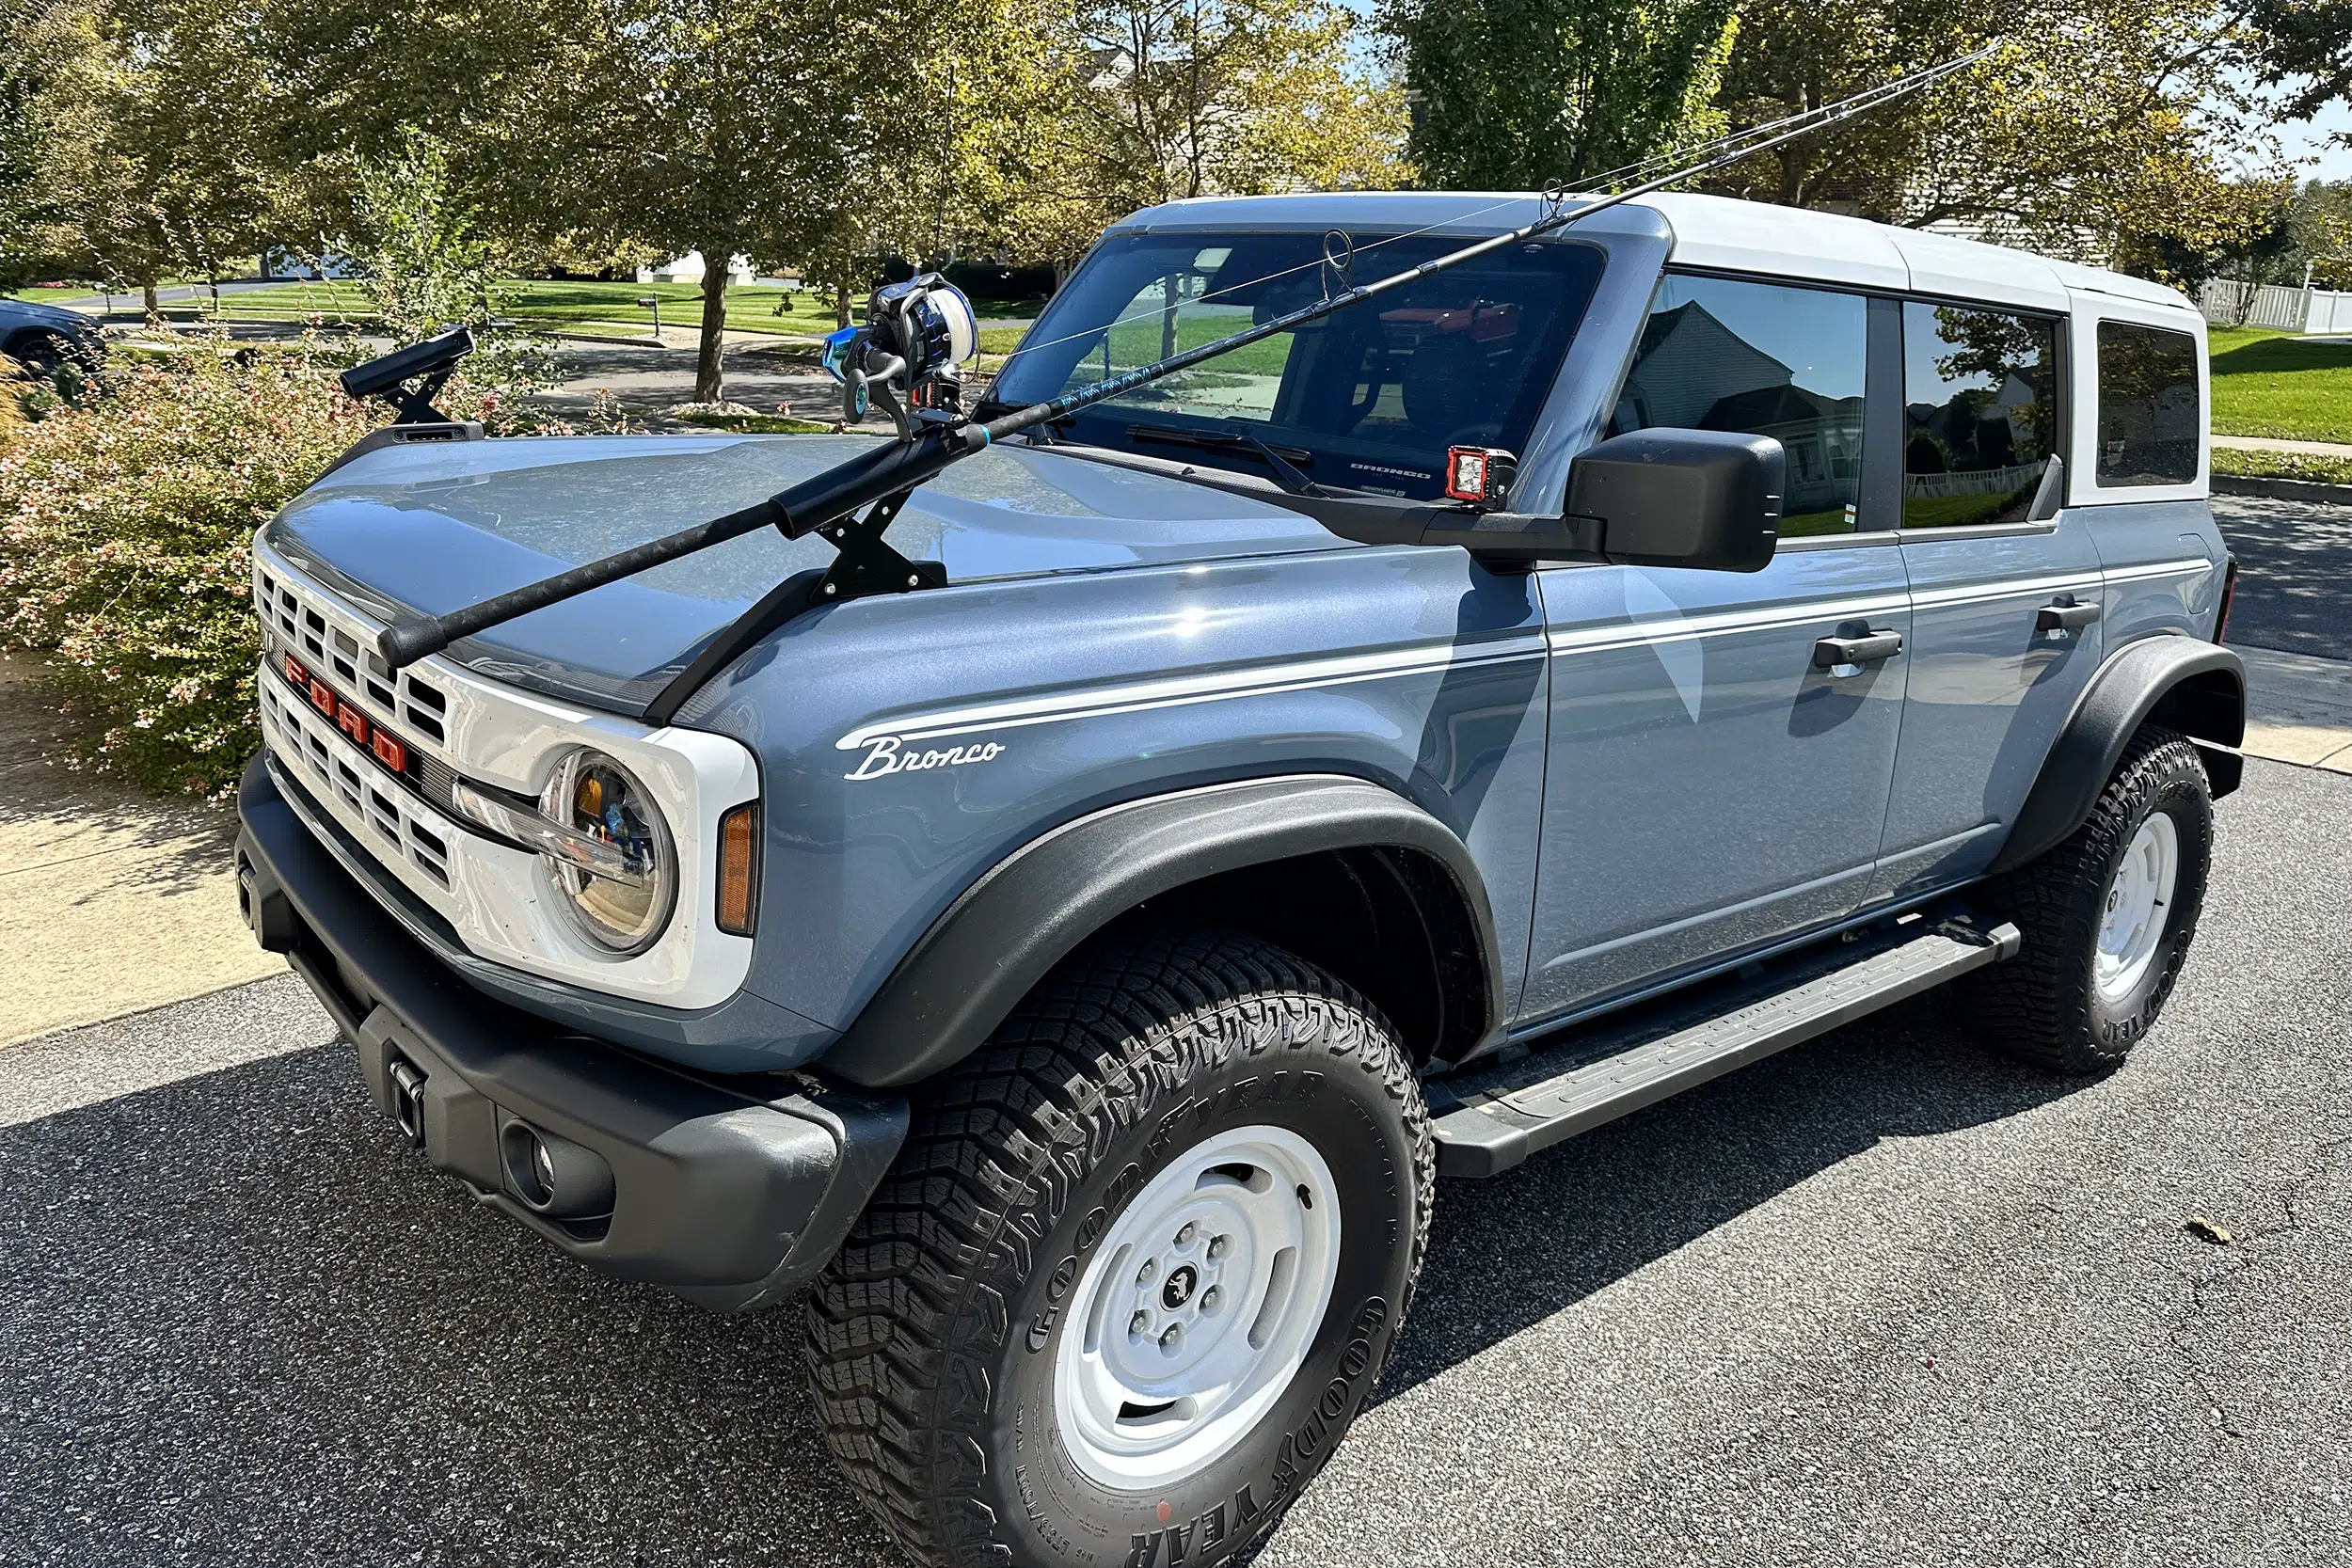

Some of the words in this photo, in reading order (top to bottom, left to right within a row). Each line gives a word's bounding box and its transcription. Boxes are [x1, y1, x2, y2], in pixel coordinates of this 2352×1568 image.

[1349, 463, 1432, 480] BRONCO
[285, 655, 406, 773] FORD
[843, 735, 1006, 781] Bronco
